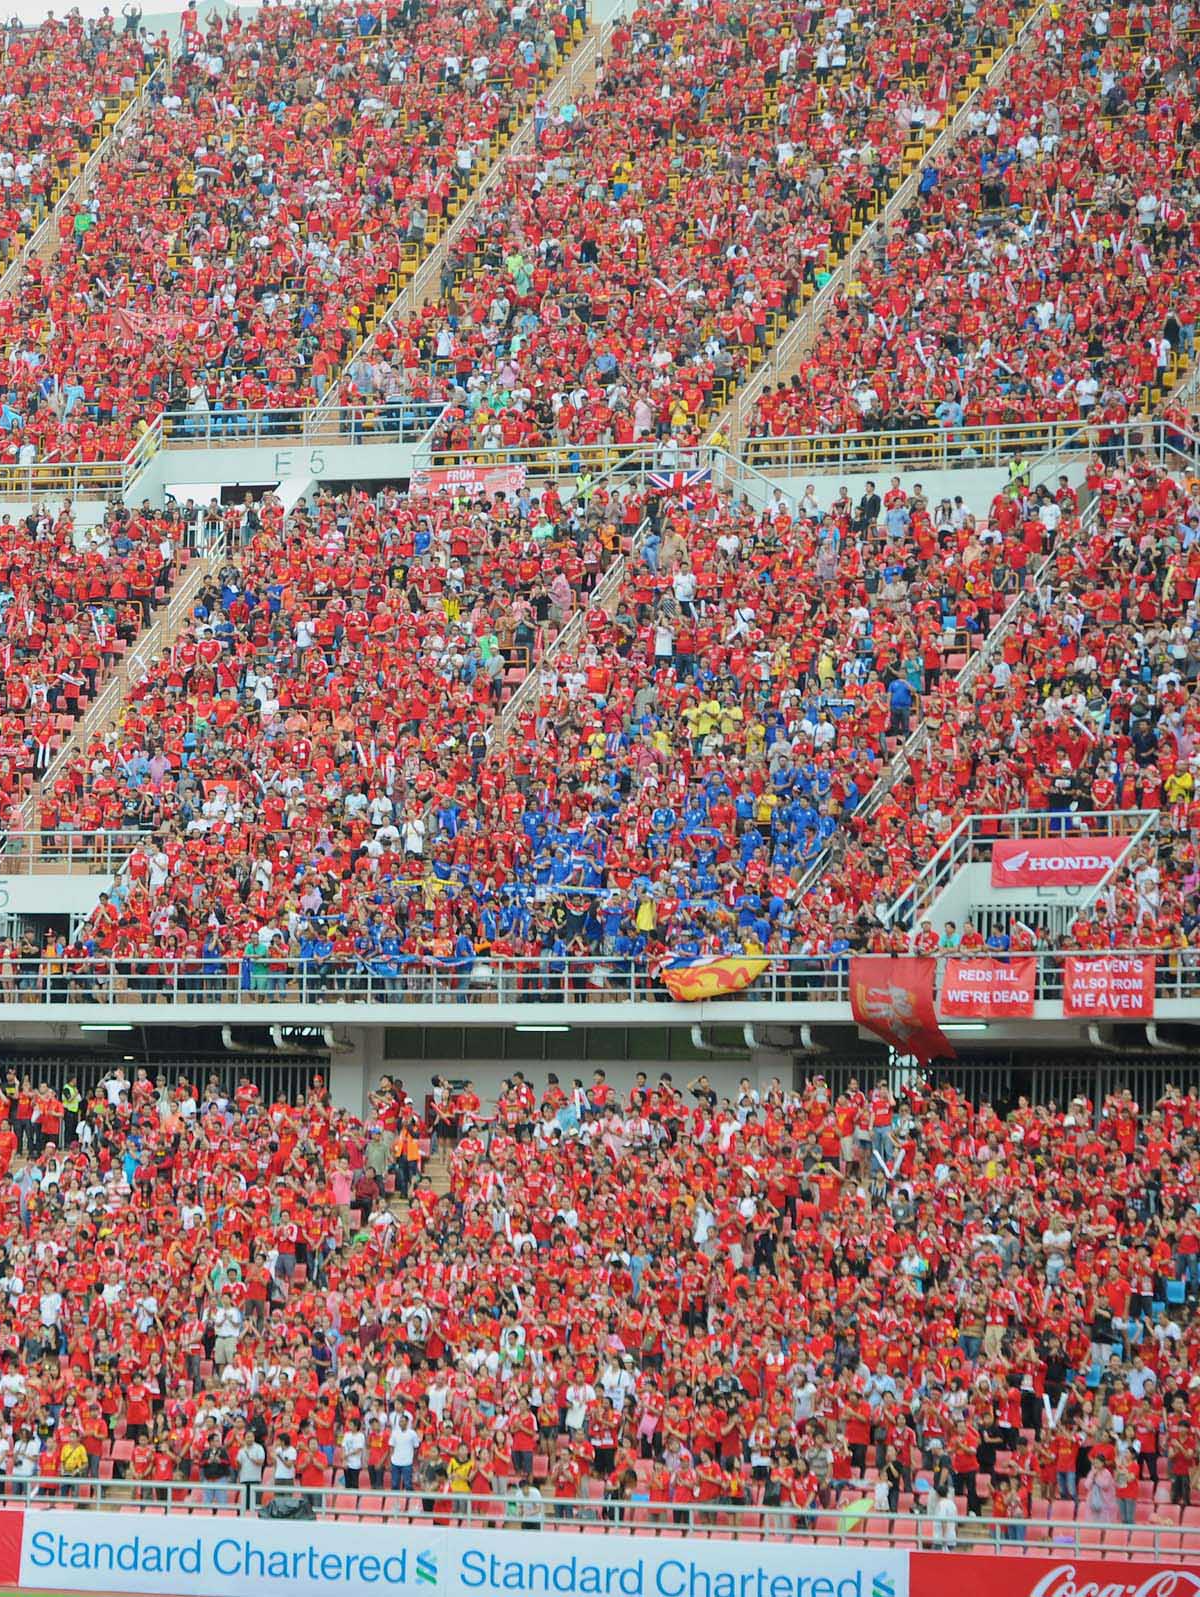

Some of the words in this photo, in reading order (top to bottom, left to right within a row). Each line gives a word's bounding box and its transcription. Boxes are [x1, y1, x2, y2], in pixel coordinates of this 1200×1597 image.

[447, 469, 476, 482] FROM
[1029, 855, 1117, 872] HONDA
[1073, 960, 1143, 974] STEVEN'S
[958, 969, 992, 982] REDS
[995, 969, 1018, 981] TILL
[1072, 978, 1107, 990] ALSO
[1110, 978, 1143, 990] FROM
[947, 990, 991, 1004] WE'RE
[992, 990, 1029, 1004] DEAD
[1072, 994, 1143, 1009] HEAVEN
[29, 1531, 201, 1578] Standard
[212, 1540, 408, 1584] Chartered
[459, 1550, 644, 1596] Standard
[655, 1560, 862, 1597] Chartered
